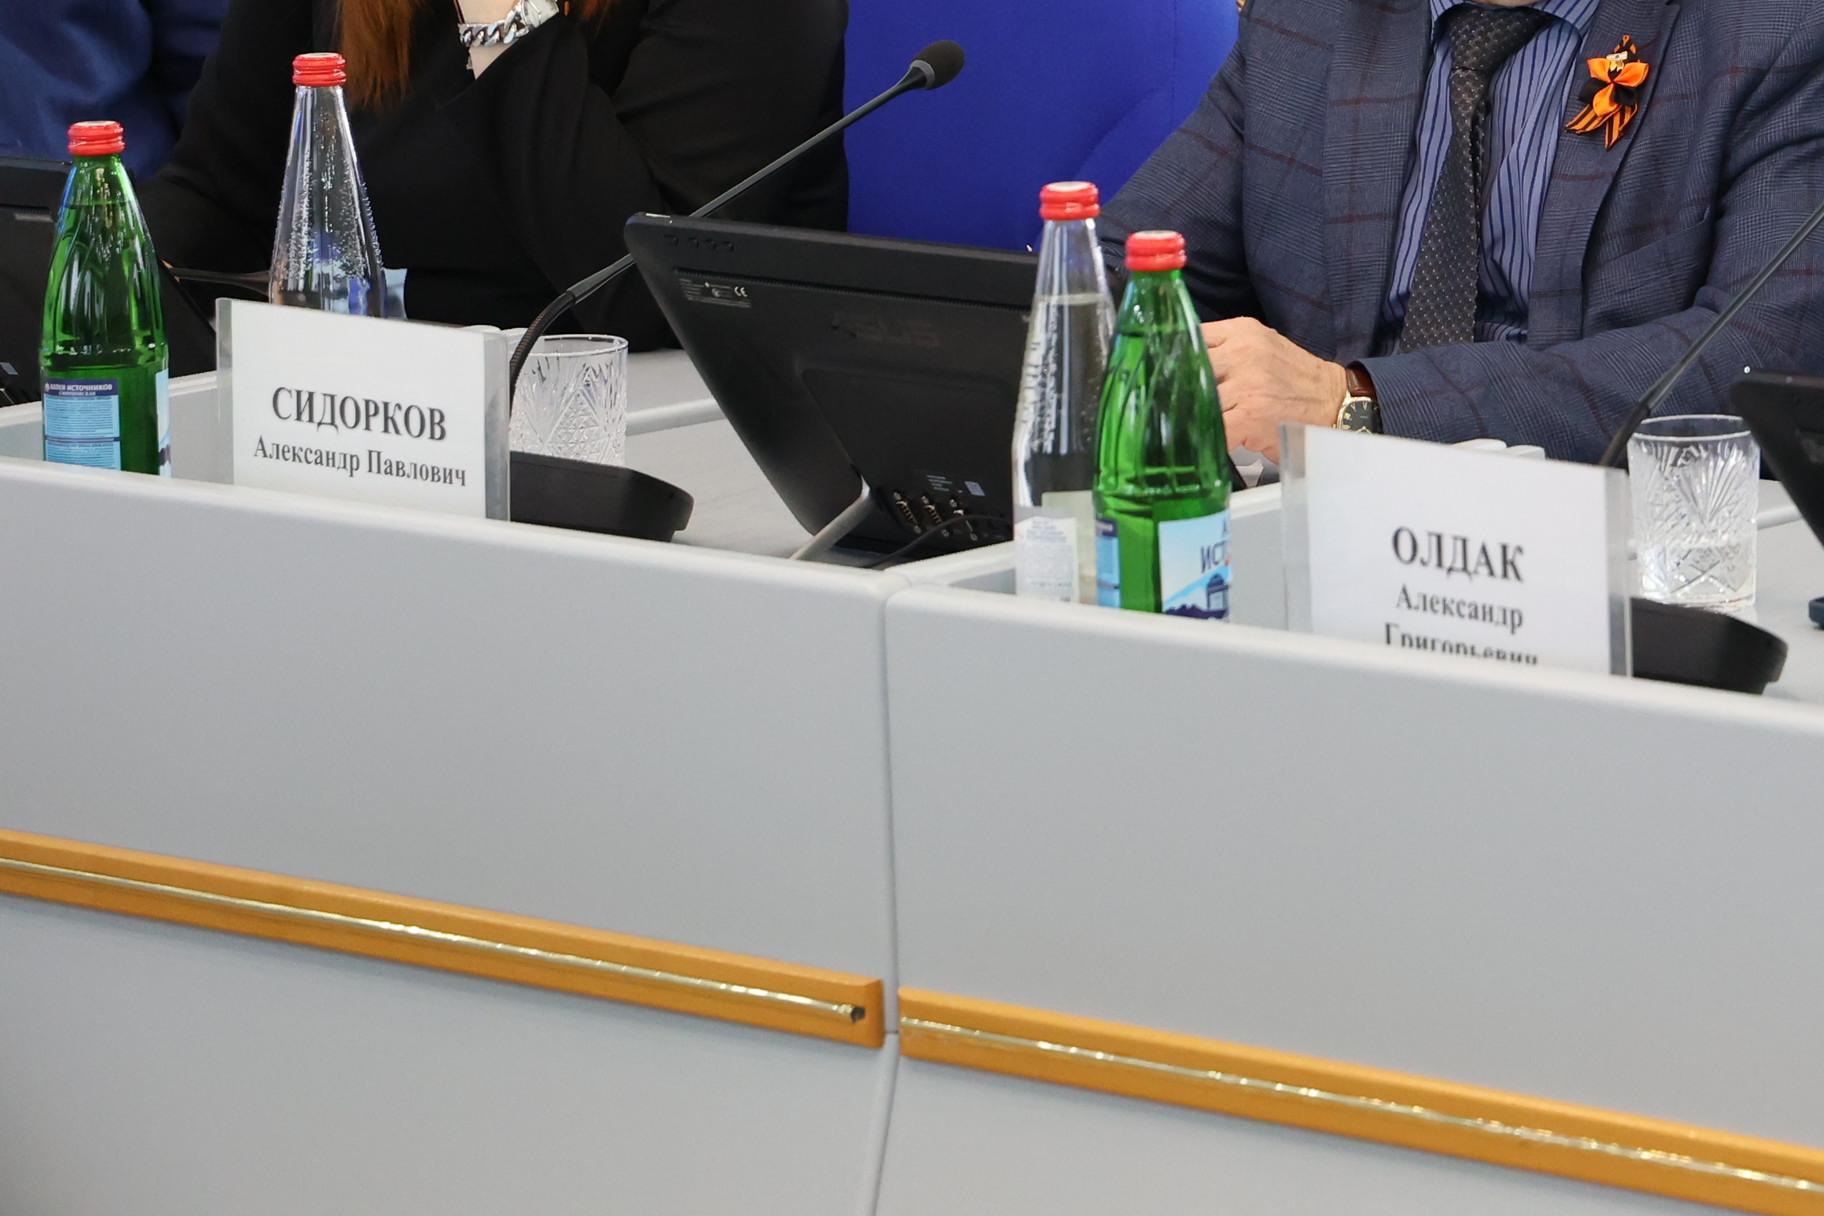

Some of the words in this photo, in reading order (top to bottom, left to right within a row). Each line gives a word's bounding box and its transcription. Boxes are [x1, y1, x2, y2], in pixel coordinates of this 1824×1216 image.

[271, 386, 447, 441] СИДОРКОВ
[253, 434, 361, 478] Александр
[366, 449, 466, 487] Павлович
[1391, 525, 1525, 582] ОЛДАК
[1395, 583, 1524, 635] Александр
